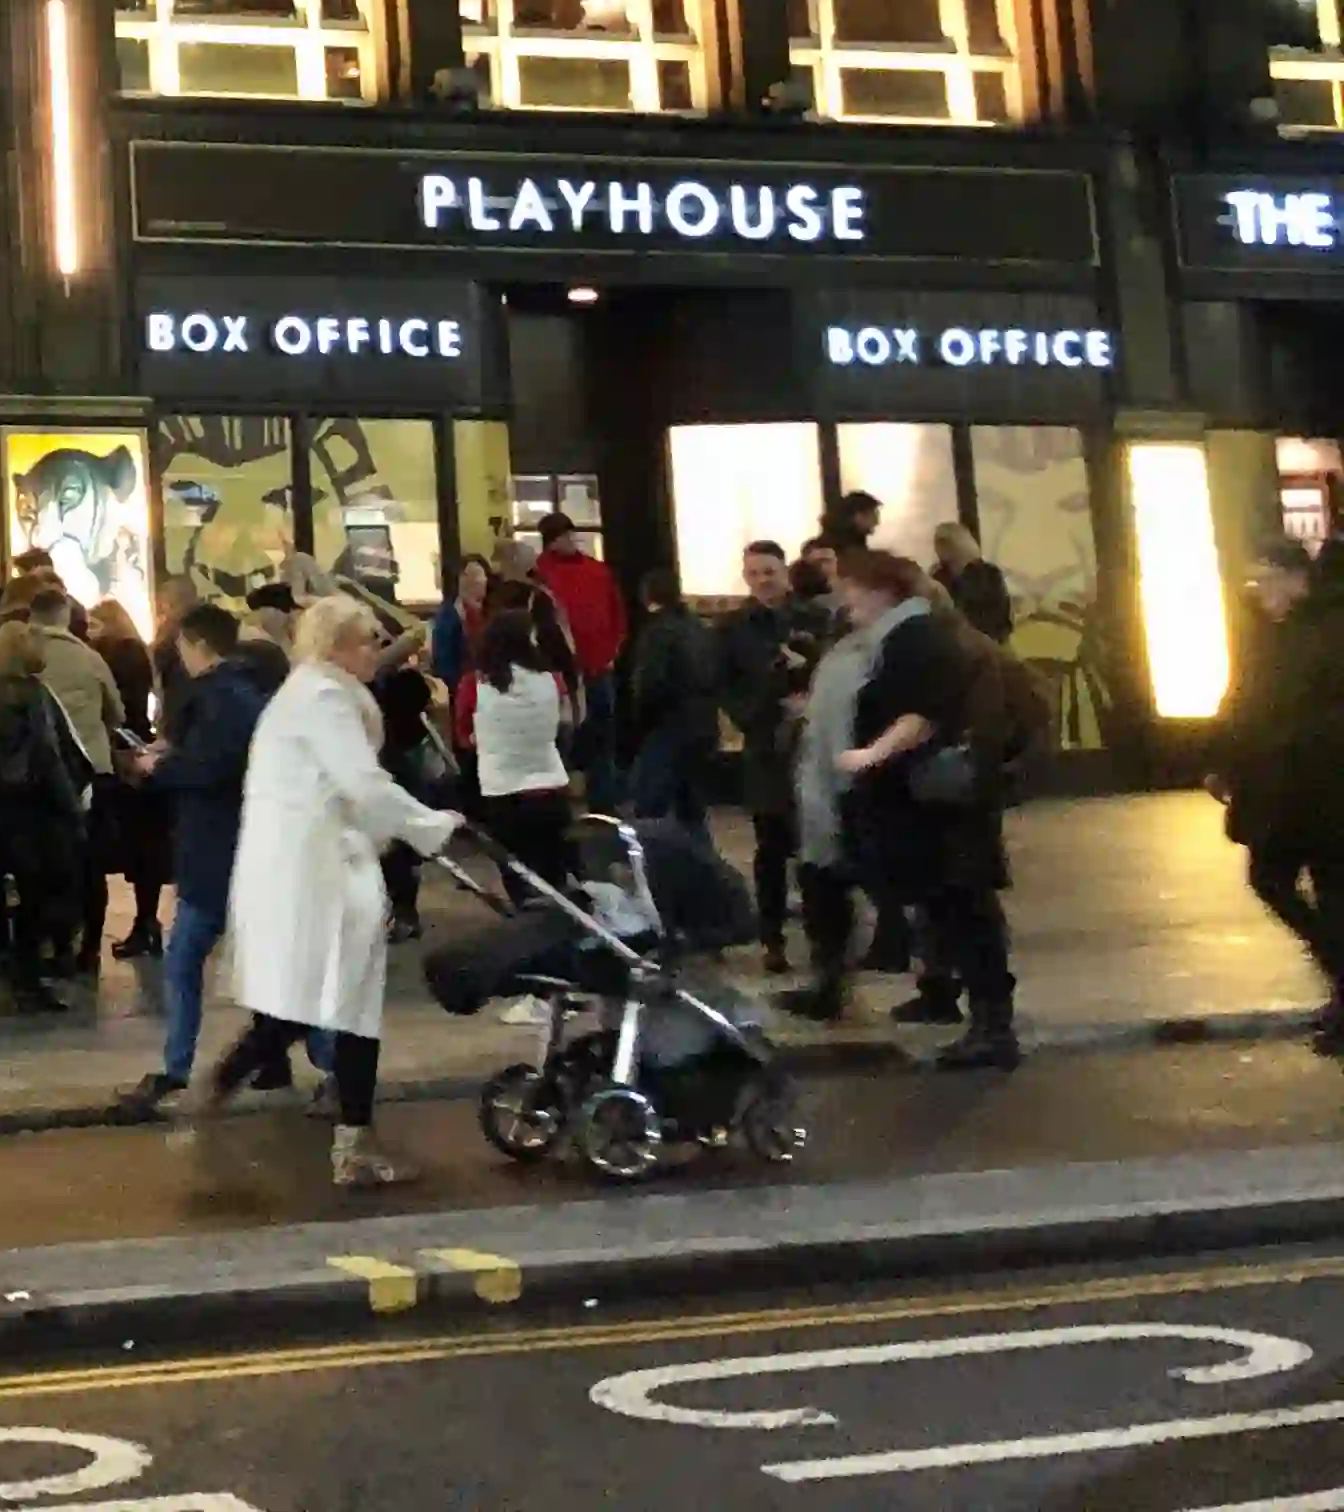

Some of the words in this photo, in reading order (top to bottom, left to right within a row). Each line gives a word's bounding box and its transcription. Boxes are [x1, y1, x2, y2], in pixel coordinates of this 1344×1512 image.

[422, 175, 866, 241] PLAYHOUSE
[1224, 189, 1335, 247] THE
[148, 313, 249, 352] BOX
[274, 317, 462, 358] OFFICE
[827, 327, 918, 365] BOX
[940, 328, 1114, 368] OFFICE
